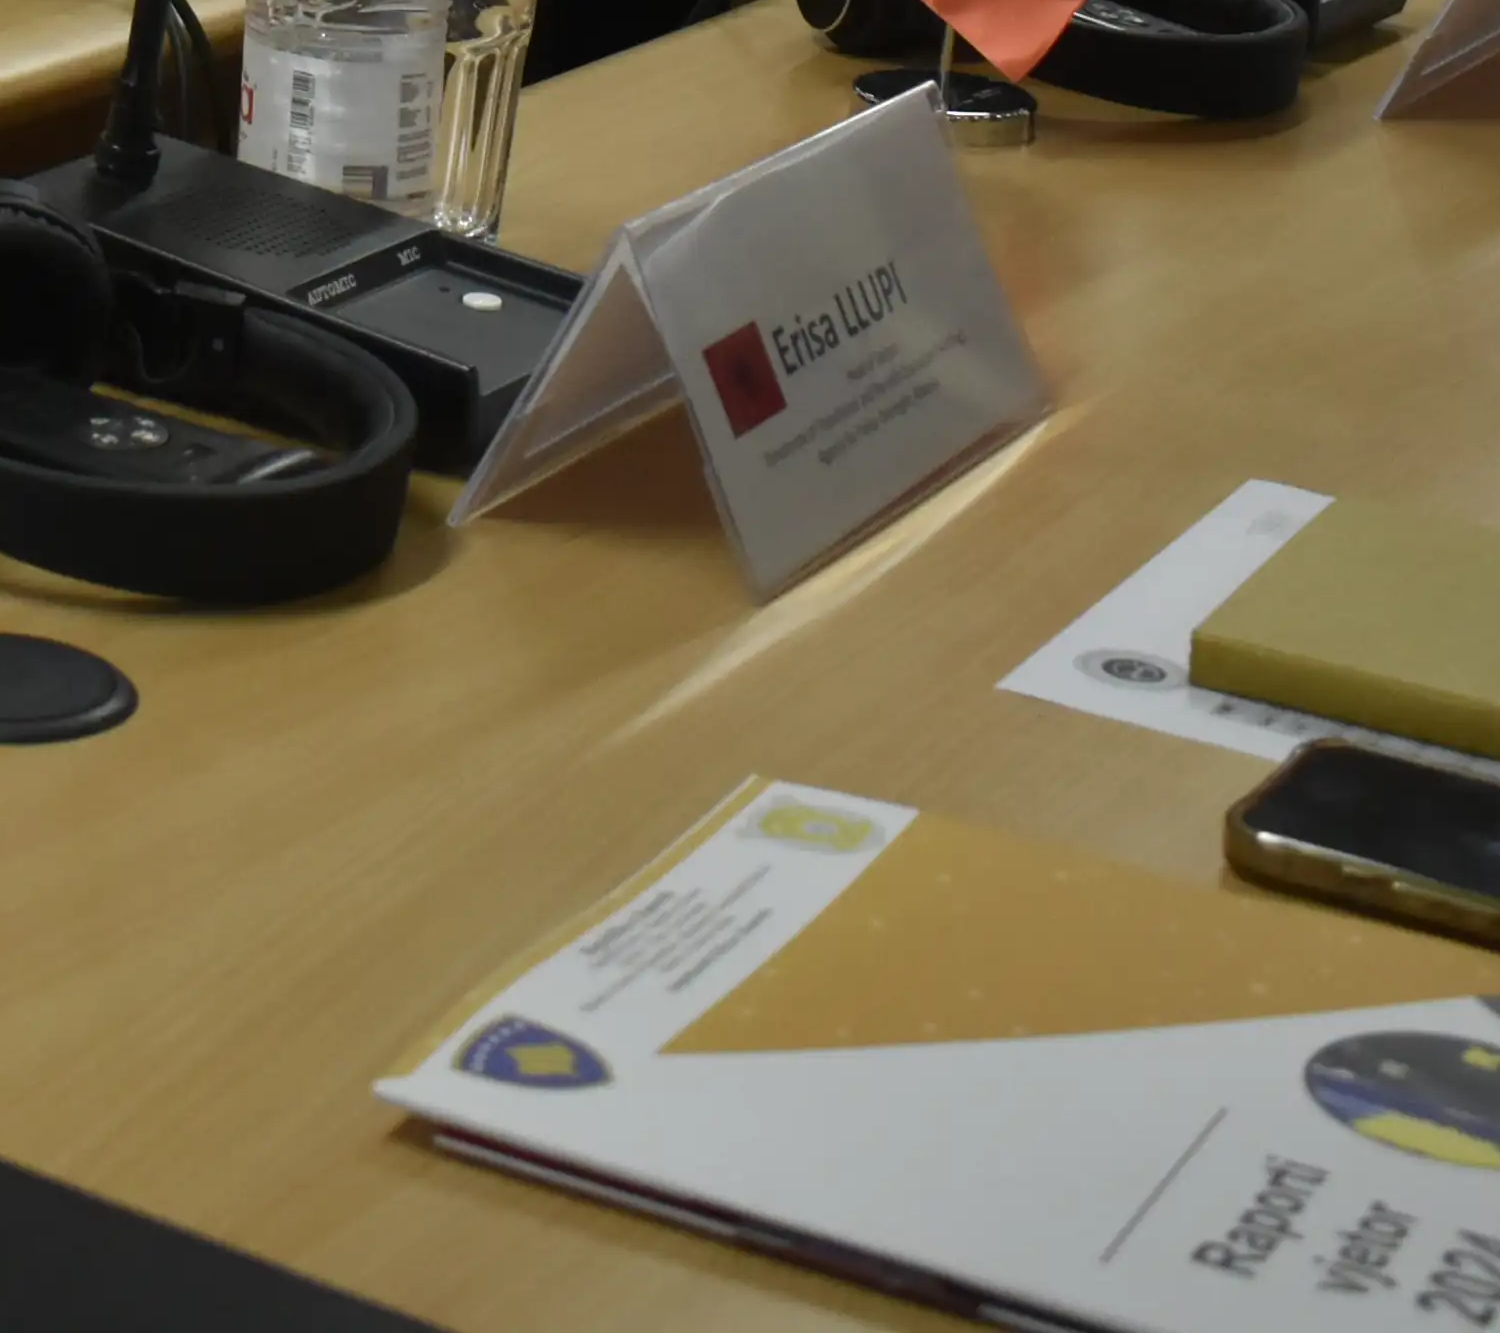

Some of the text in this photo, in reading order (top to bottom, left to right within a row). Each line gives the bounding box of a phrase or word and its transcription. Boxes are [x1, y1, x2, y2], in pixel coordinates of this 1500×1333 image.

[397, 245, 421, 267] MIC
[771, 312, 841, 377] Erisa
[832, 260, 909, 337] LLUPI
[1191, 1154, 1331, 1279] Raporti
[1312, 1199, 1419, 1296] vjetor
